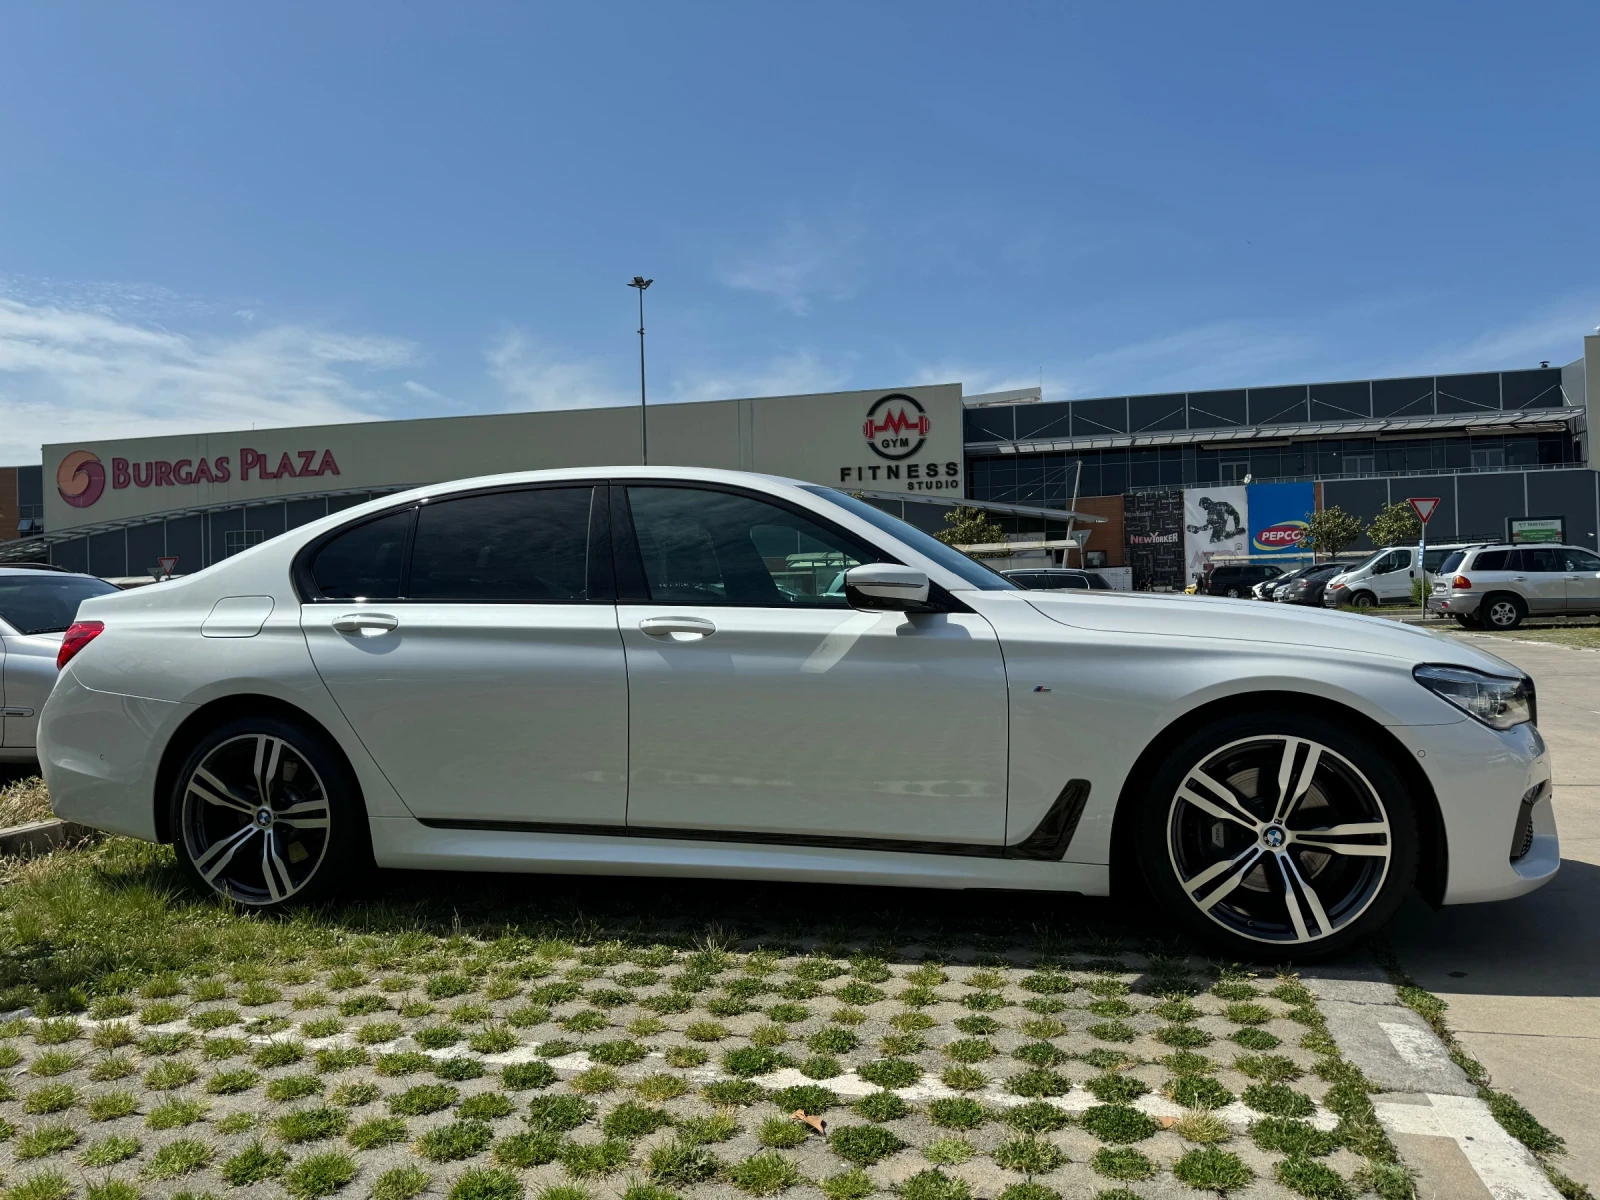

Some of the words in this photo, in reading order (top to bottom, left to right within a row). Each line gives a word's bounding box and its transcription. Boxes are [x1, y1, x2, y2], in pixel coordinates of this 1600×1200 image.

[881, 438, 909, 449] GYM
[112, 456, 231, 489] BURGAS
[240, 447, 340, 481] PLAZA
[840, 462, 959, 482] FITNESS
[907, 480, 959, 490] STUDIO
